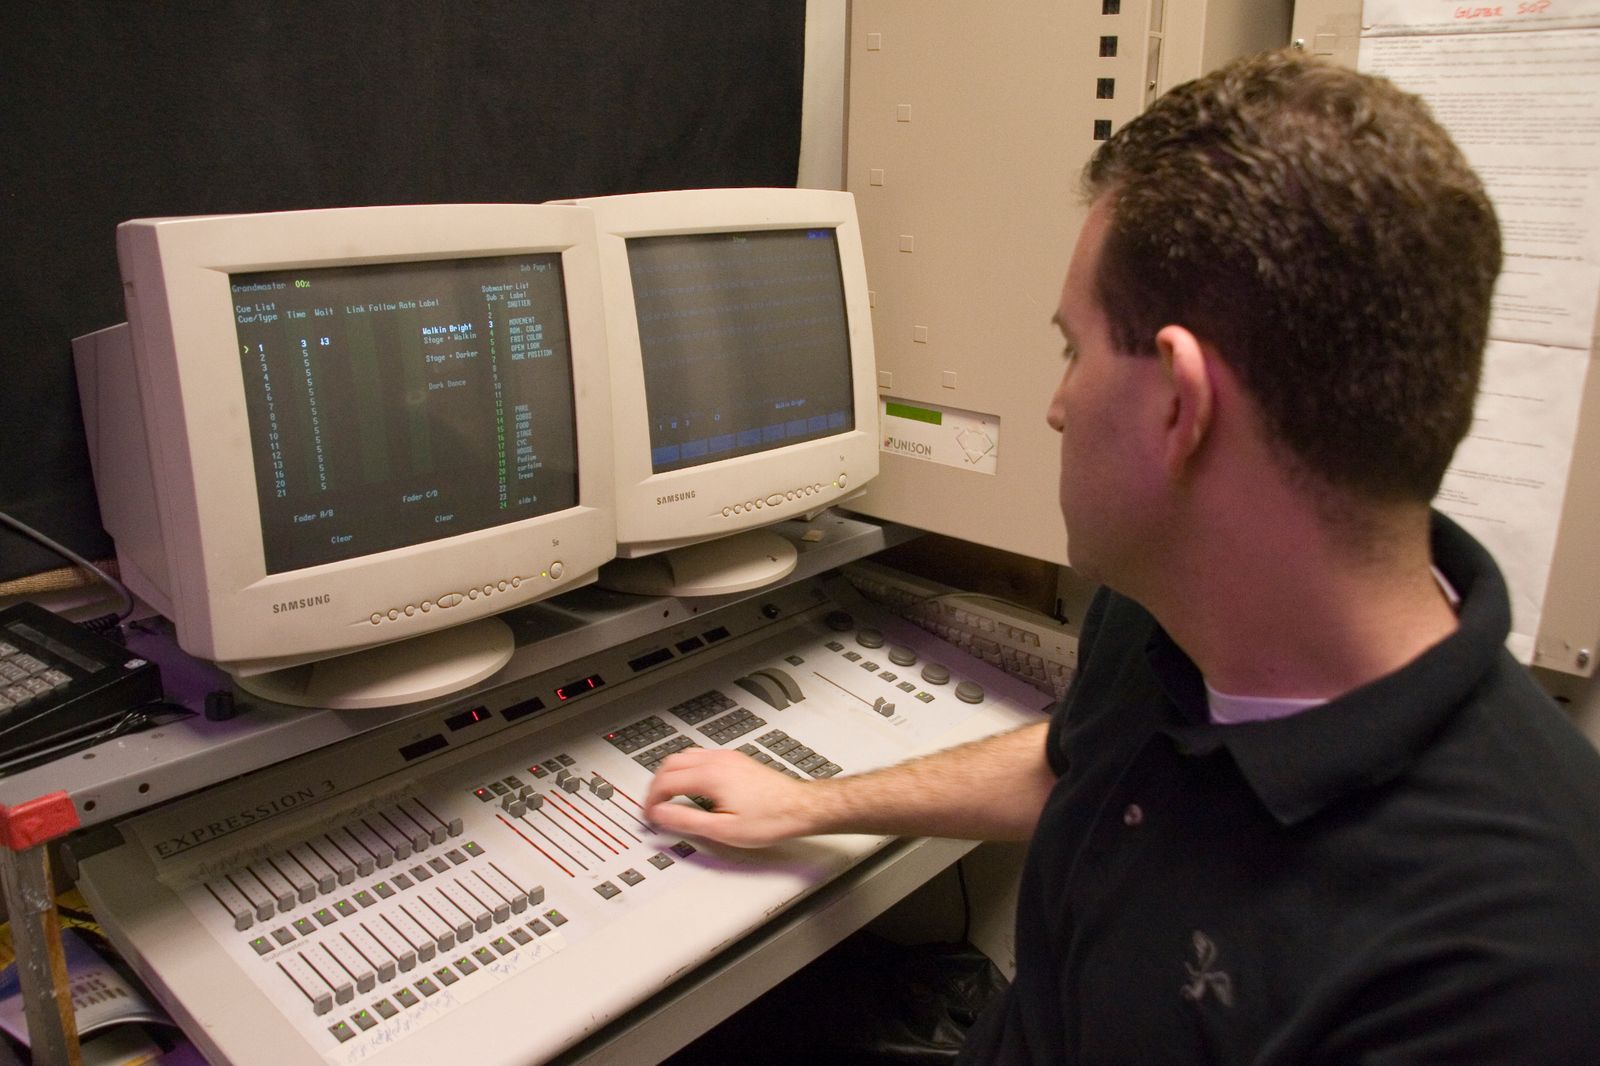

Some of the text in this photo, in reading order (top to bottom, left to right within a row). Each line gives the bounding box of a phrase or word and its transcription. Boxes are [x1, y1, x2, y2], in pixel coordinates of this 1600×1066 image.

[232, 282, 286, 292] Grandmaster
[236, 302, 275, 314] Cue List
[238, 299, 439, 324] Cue/Type Time Wait Link Follow Rate Label
[422, 323, 472, 334] Walkin Bright
[423, 336, 444, 344] Stage
[425, 350, 478, 363] Stage Darker
[893, 438, 932, 456] UNISON
[402, 489, 438, 503] Fader C/D
[656, 490, 696, 505] SAMSUNG
[294, 509, 334, 523] Fader A/B
[435, 514, 454, 523] Clear
[331, 534, 353, 544] Clear
[273, 594, 330, 613] SAMSUNG
[155, 787, 315, 856] EXPRESSION
[321, 780, 336, 792] 3
